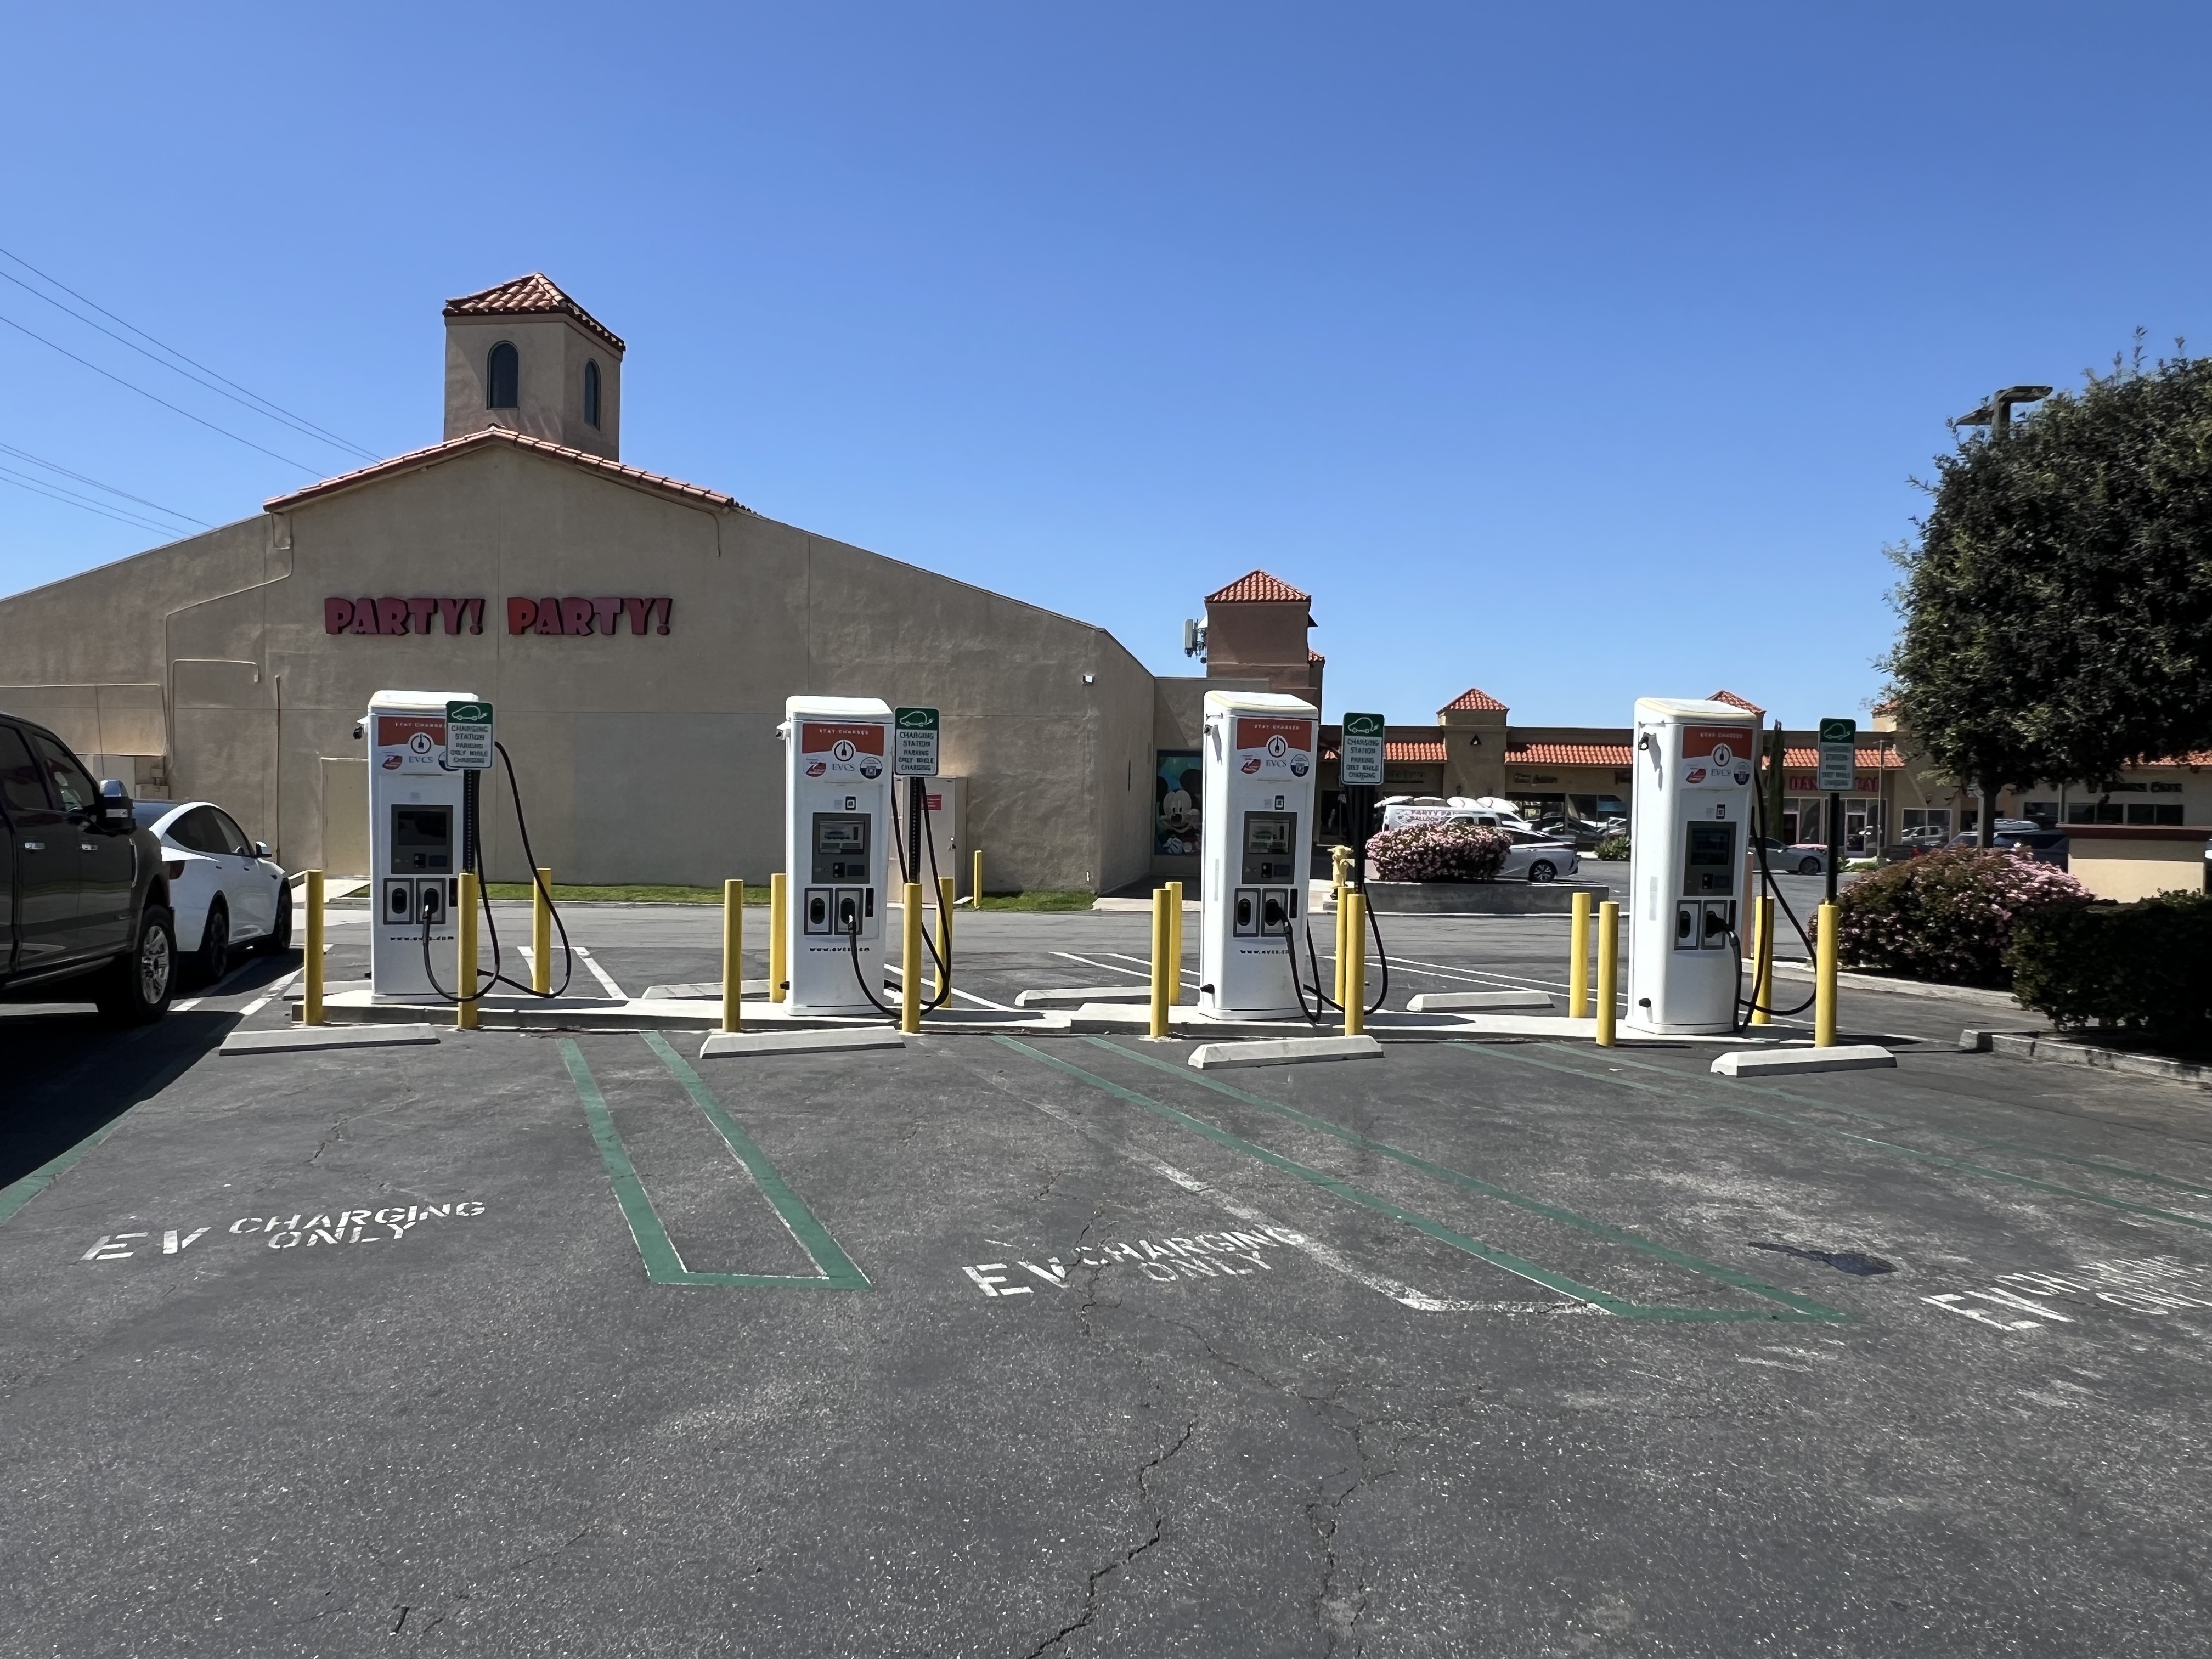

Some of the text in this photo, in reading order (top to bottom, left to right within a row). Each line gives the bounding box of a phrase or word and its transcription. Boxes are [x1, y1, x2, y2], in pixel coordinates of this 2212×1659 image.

[324, 596, 673, 637] PARTY! PARTY!
[832, 763, 855, 771] EVCS
[80, 1201, 486, 1261] EV CHARGING
[267, 1221, 417, 1249] ONLY
[962, 1257, 1069, 1297] EV
